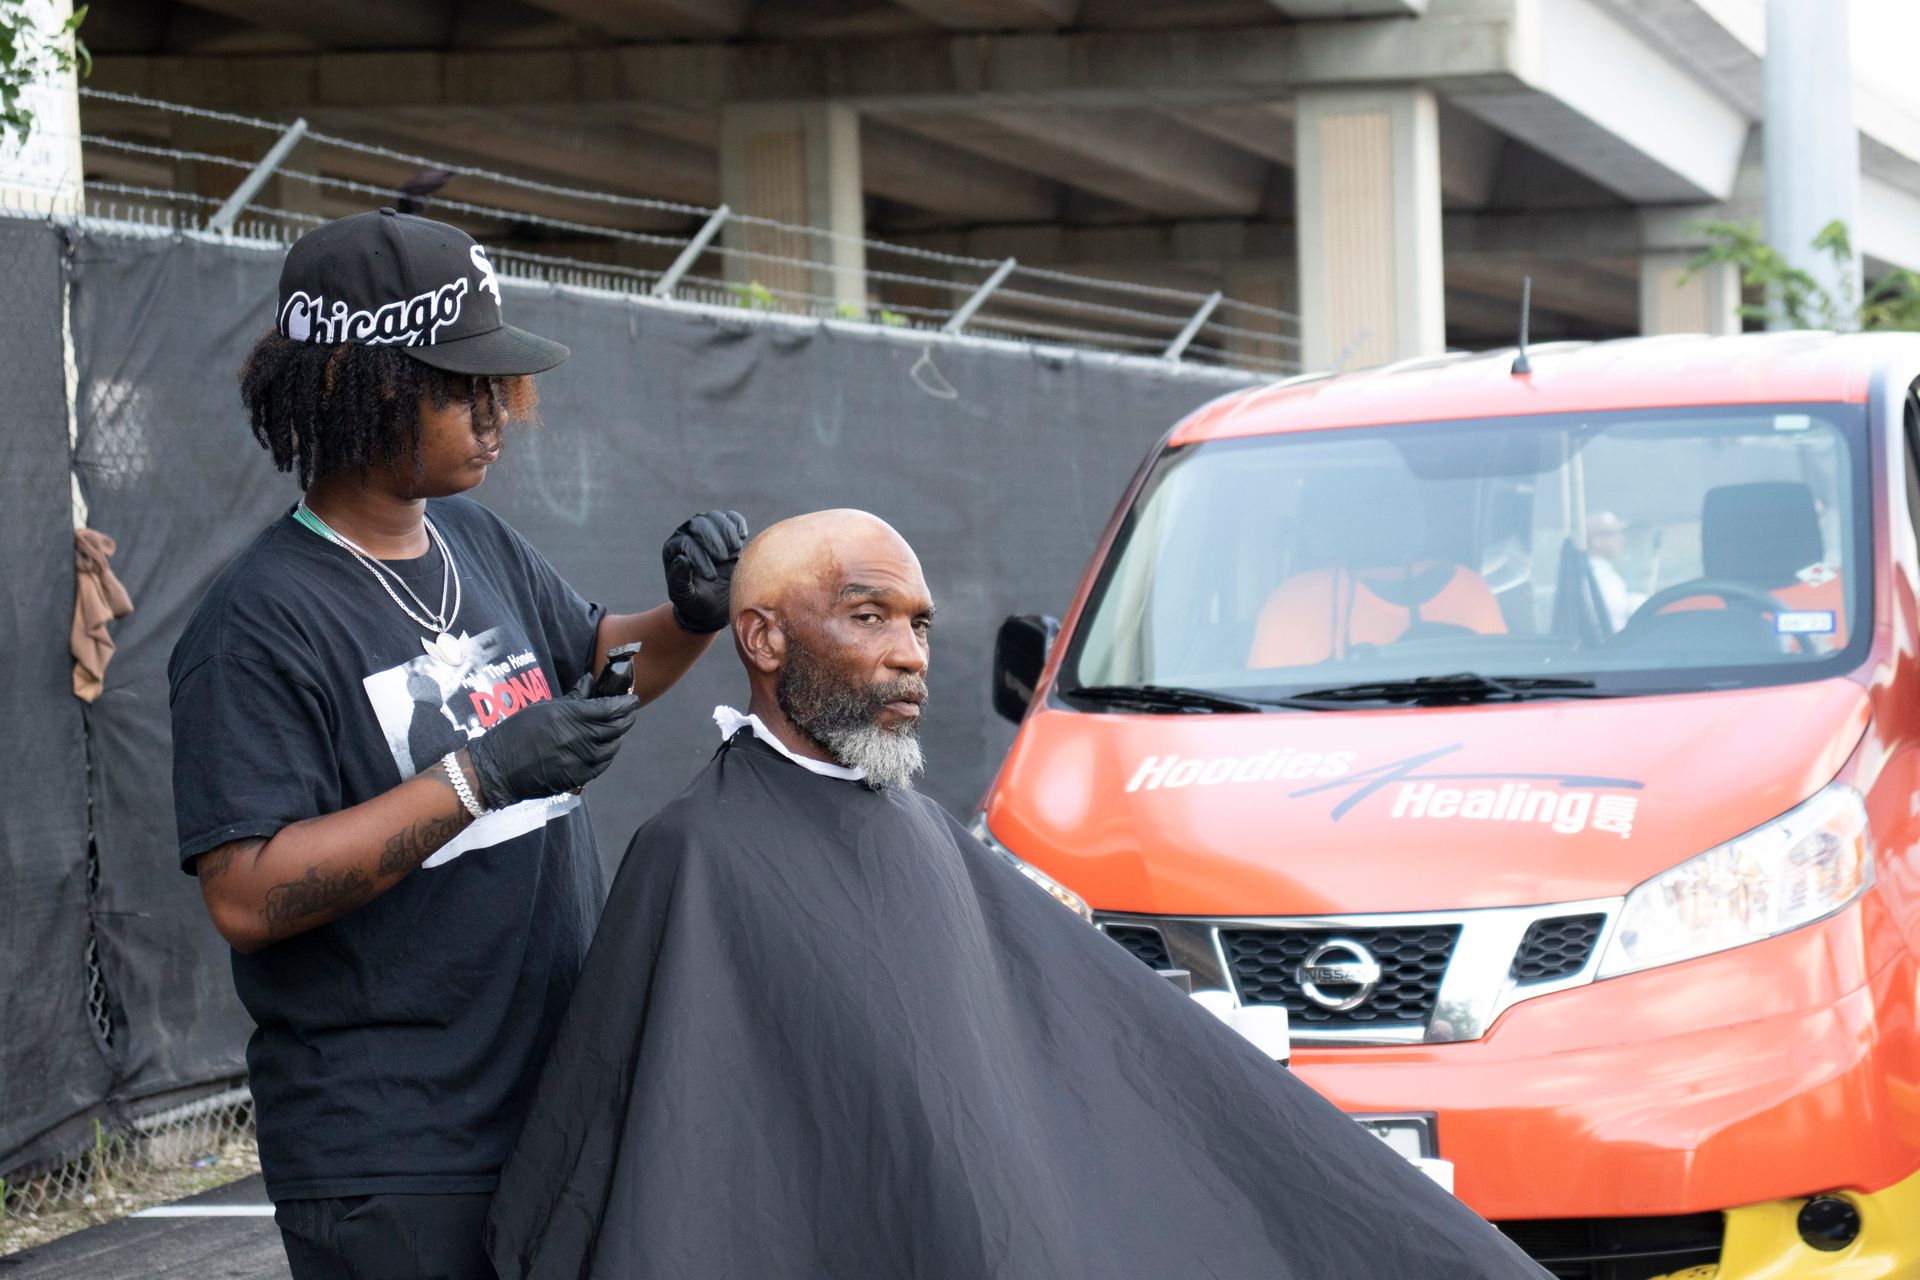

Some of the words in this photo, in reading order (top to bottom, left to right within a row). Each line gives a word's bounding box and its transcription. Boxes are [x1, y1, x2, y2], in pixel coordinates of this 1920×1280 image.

[281, 277, 468, 347] Chicago
[483, 662, 511, 679] The
[469, 667, 552, 728] DONAT
[1125, 748, 1357, 793] Hoodies
[1391, 782, 1594, 834] Healing
[1305, 967, 1369, 981] NISSA
